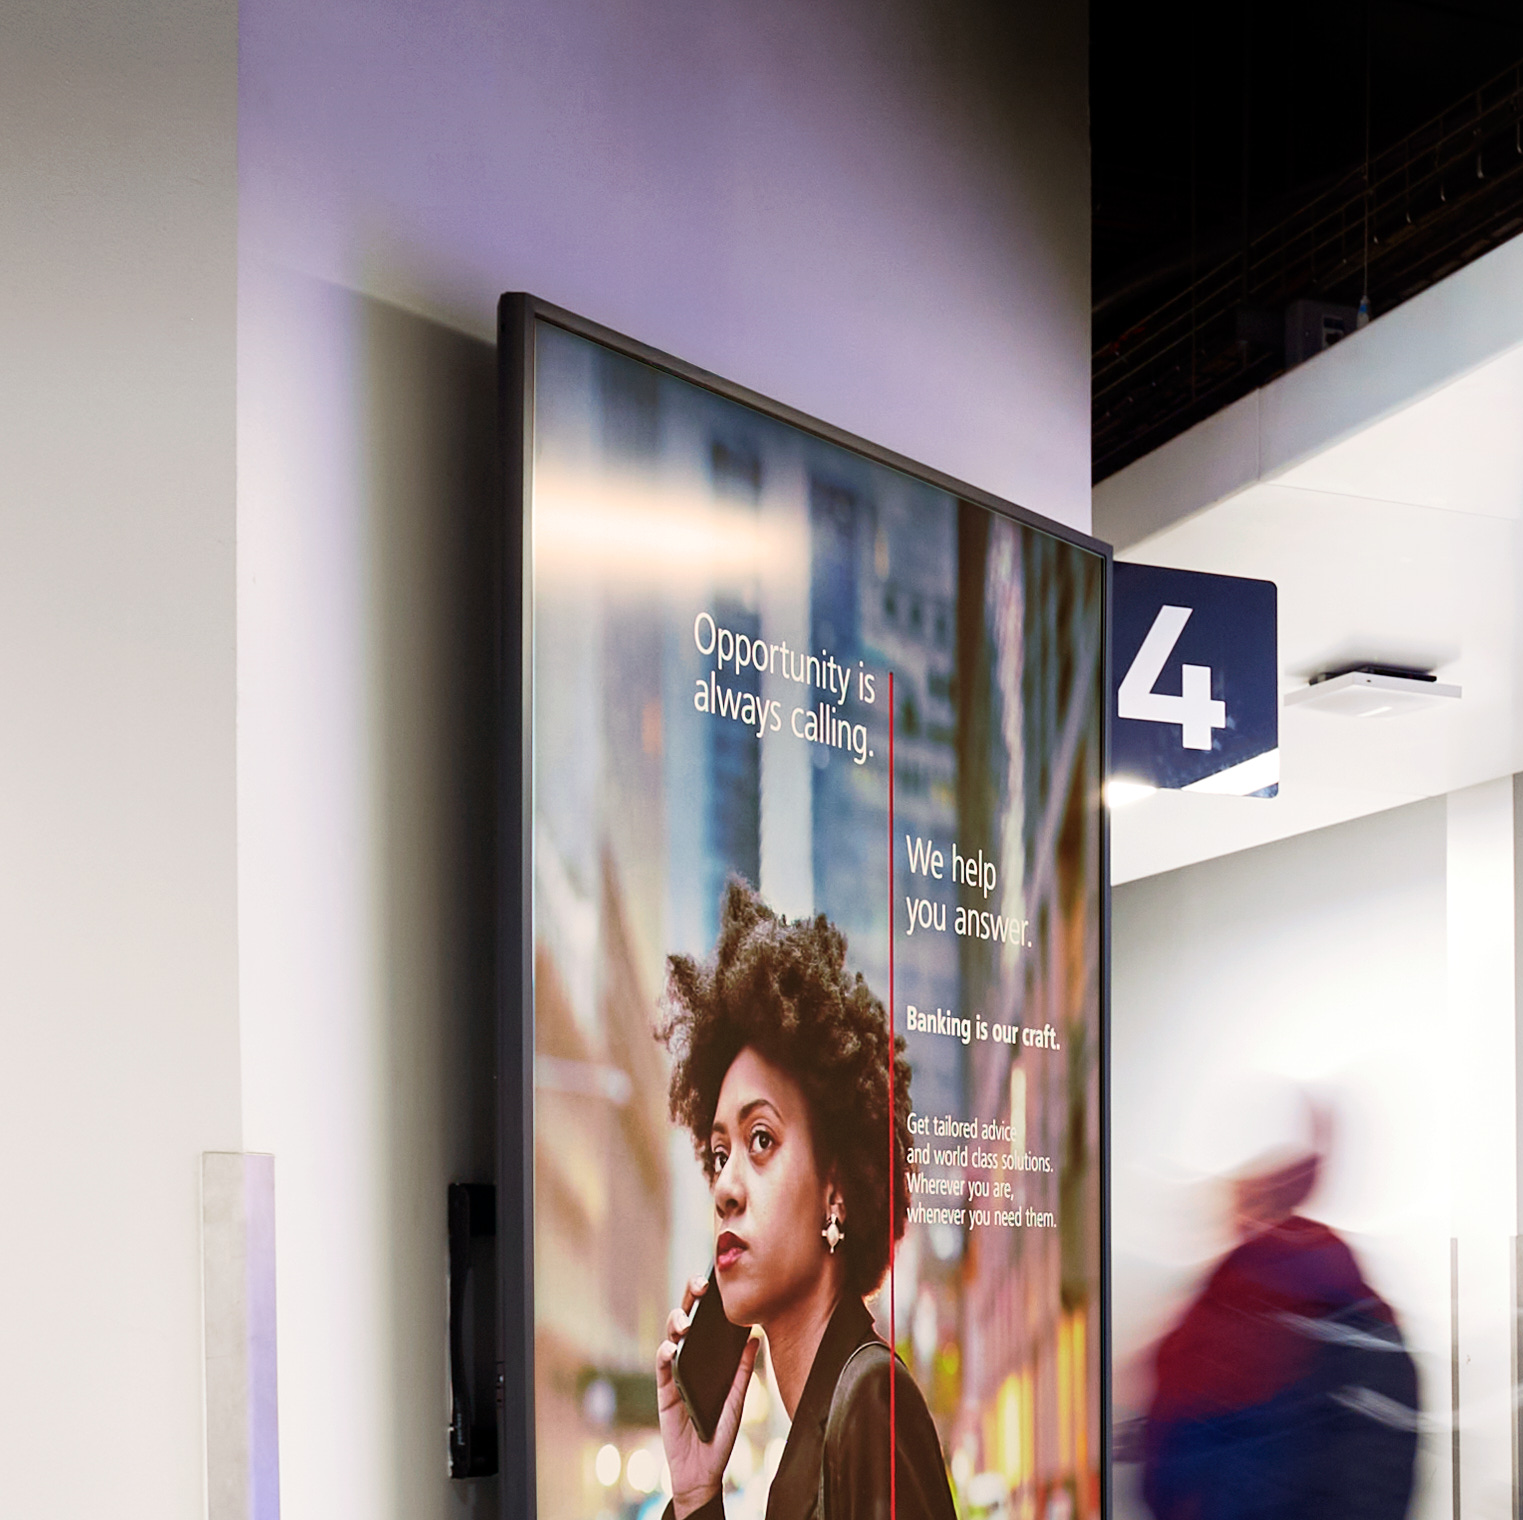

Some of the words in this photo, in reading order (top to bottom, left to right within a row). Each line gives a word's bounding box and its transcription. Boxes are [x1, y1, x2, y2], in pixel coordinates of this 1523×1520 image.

[693, 612, 851, 705] Opportunity
[858, 661, 876, 704] is
[1118, 604, 1226, 750] 4
[693, 670, 781, 738] always
[791, 701, 875, 765] calling.
[905, 835, 944, 879] We
[951, 844, 997, 898] help
[905, 896, 946, 935] you
[954, 905, 1033, 948] answer.
[907, 1005, 971, 1045] Banking
[975, 1014, 988, 1041] is
[992, 1024, 1019, 1044] our
[1022, 1024, 1060, 1050] craft.
[907, 1113, 929, 1135] Get
[933, 1115, 978, 1139] tailored
[981, 1119, 1017, 1142] advice
[907, 1143, 930, 1165] and
[934, 1145, 968, 1167] world
[972, 1150, 998, 1169] class
[1001, 1151, 1054, 1173] solutions.
[906, 1172, 965, 1195] Wherever
[968, 1180, 989, 1202] you
[993, 1181, 1014, 1201] are,
[907, 1202, 965, 1225] whenever
[969, 1210, 990, 1230] you
[994, 1206, 1022, 1227] need
[1025, 1207, 1057, 1228] them.
